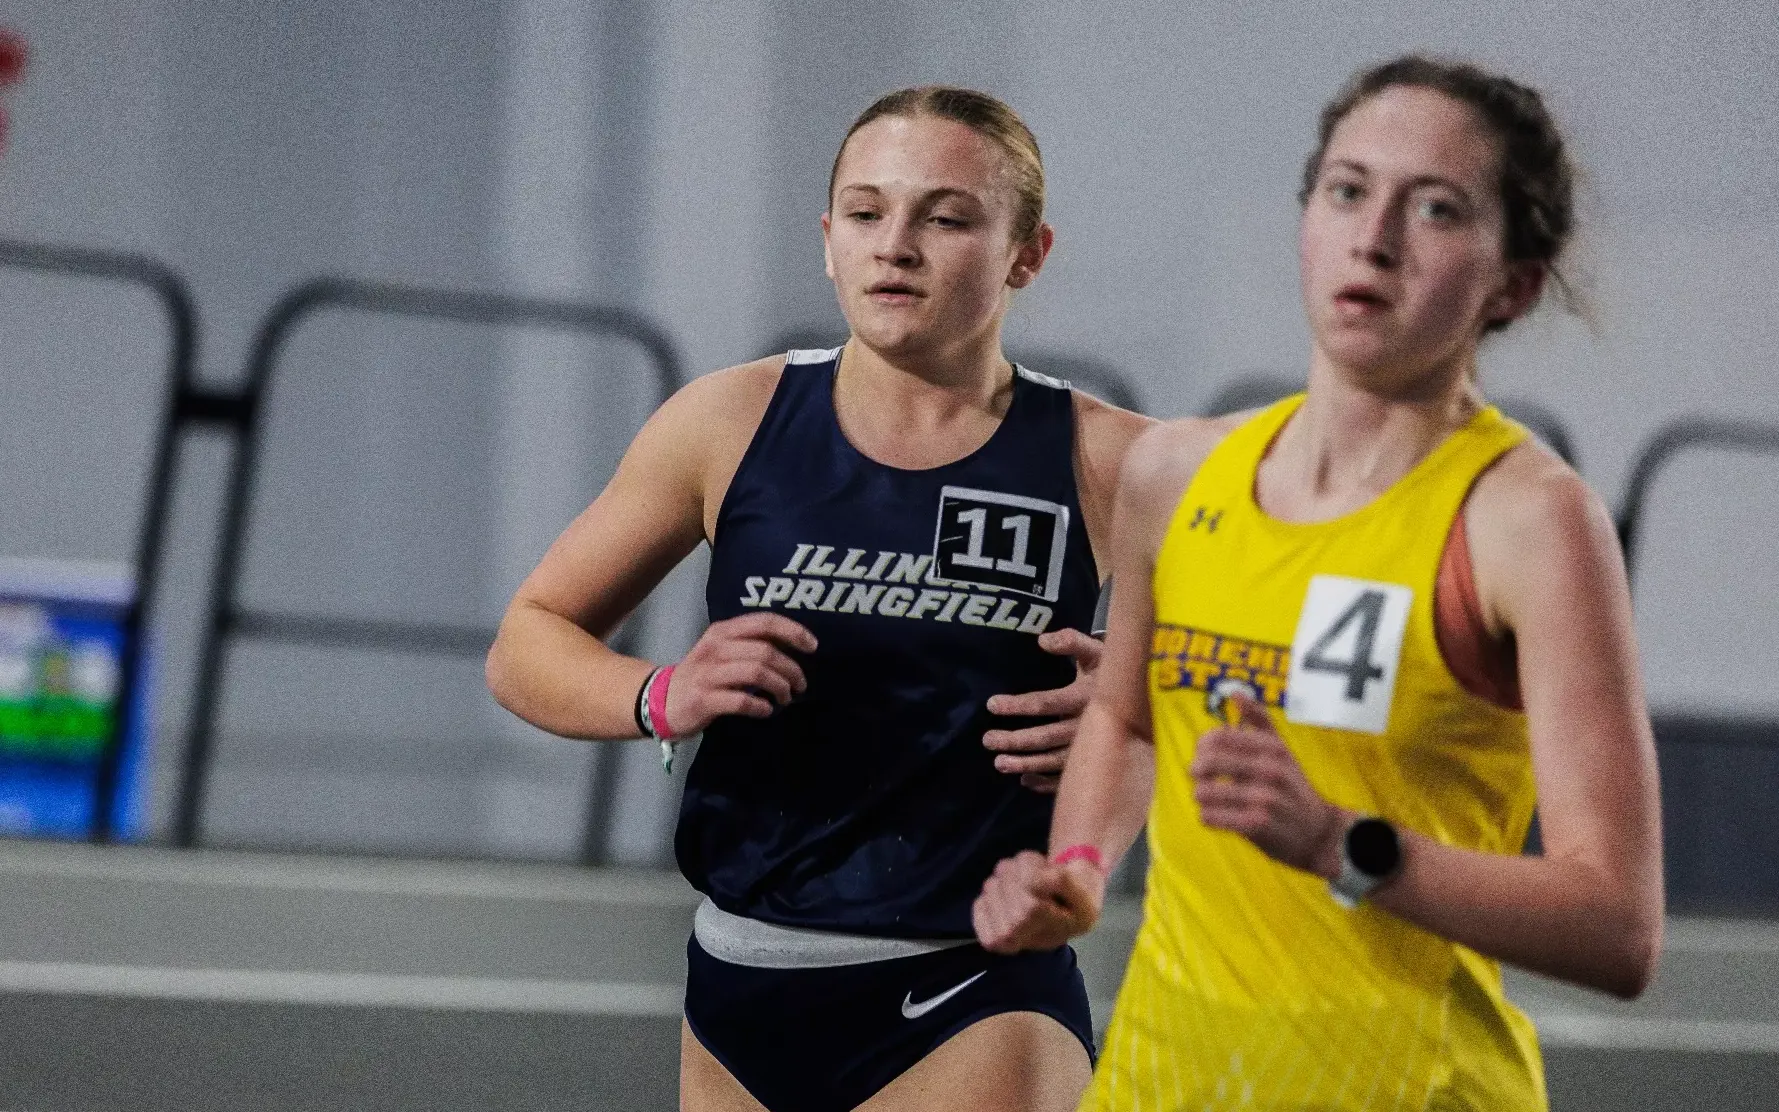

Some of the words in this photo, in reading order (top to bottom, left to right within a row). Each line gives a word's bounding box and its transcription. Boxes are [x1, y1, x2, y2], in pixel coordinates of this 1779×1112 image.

[782, 543, 1001, 593] ILLIN
[951, 508, 1037, 579] 11
[740, 576, 1054, 635] SPRINGFIELD
[1302, 588, 1387, 702] 4
